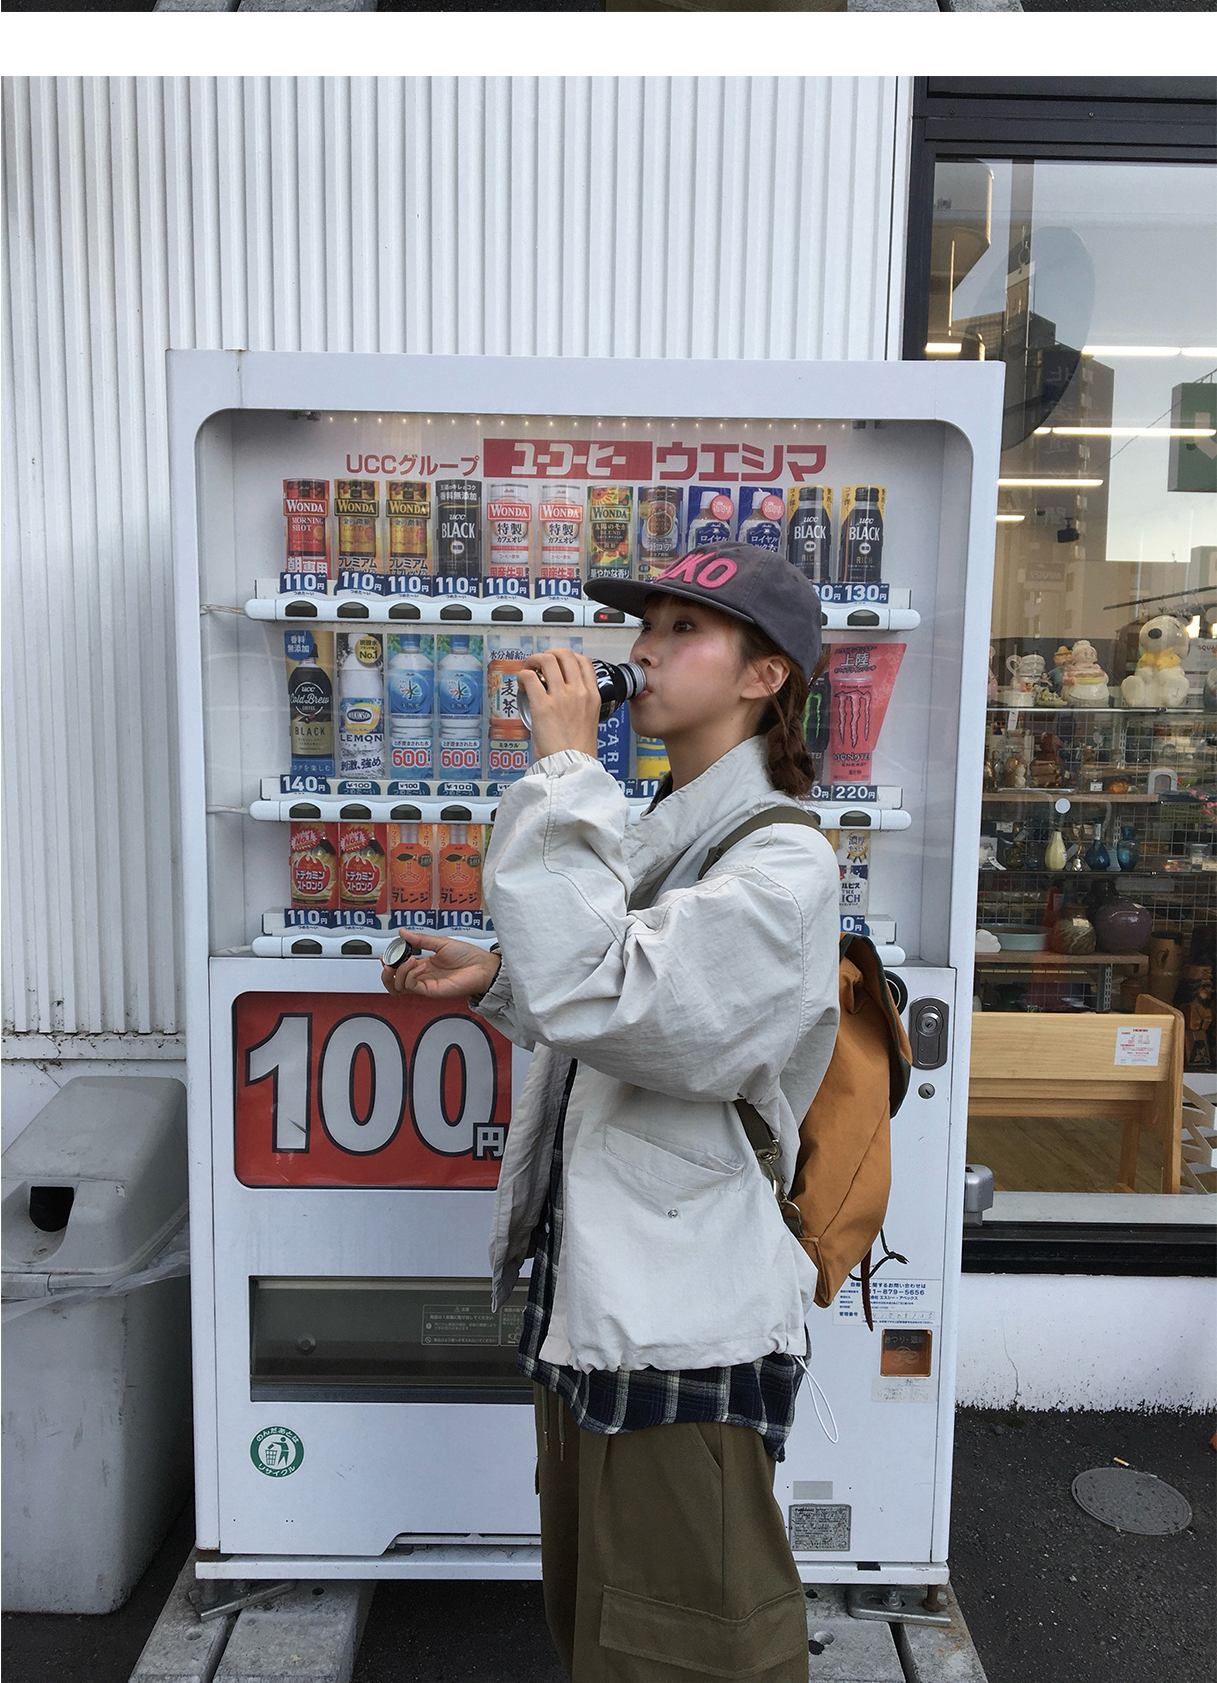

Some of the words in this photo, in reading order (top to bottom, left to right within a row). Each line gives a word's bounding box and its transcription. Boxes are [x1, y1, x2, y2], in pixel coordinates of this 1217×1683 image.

[346, 454, 480, 476] UCCグループ
[656, 441, 827, 482] ウエシマ
[286, 500, 325, 513] WONDA
[337, 500, 375, 513] WONDA
[491, 506, 528, 518] WONDA
[291, 517, 324, 525] MORNING
[442, 522, 475, 539] BLACK
[497, 523, 522, 535] 特製
[549, 523, 574, 536] 特製
[794, 525, 827, 540] BLACK
[849, 526, 880, 541] BLACK
[497, 536, 523, 544] カフェオレ
[339, 557, 377, 568] プレミアム
[856, 556, 873, 564] RICH
[284, 574, 324, 590] 110円
[342, 572, 382, 591] 110円
[388, 576, 429, 592] 110円
[845, 585, 887, 601] 130円
[287, 644, 310, 653] 無添加
[359, 651, 379, 659] No.1
[841, 653, 870, 667] 上陸
[501, 679, 518, 717] 麦茶
[347, 710, 372, 720] WILKINSON
[340, 734, 383, 742] LEMON
[393, 750, 427, 767] 600
[441, 750, 476, 767] 600
[283, 775, 326, 791] 140円
[836, 787, 875, 799] 220円
[295, 870, 325, 881] ドデカミン
[345, 870, 374, 881] ドデカミン
[297, 882, 323, 891] ストロング
[347, 882, 373, 891] ストロング
[841, 894, 860, 903] ICH
[244, 1012, 506, 1161] 100円
[256, 1427, 299, 1443] のんだあとは
[258, 1463, 295, 1476] リサイクル
